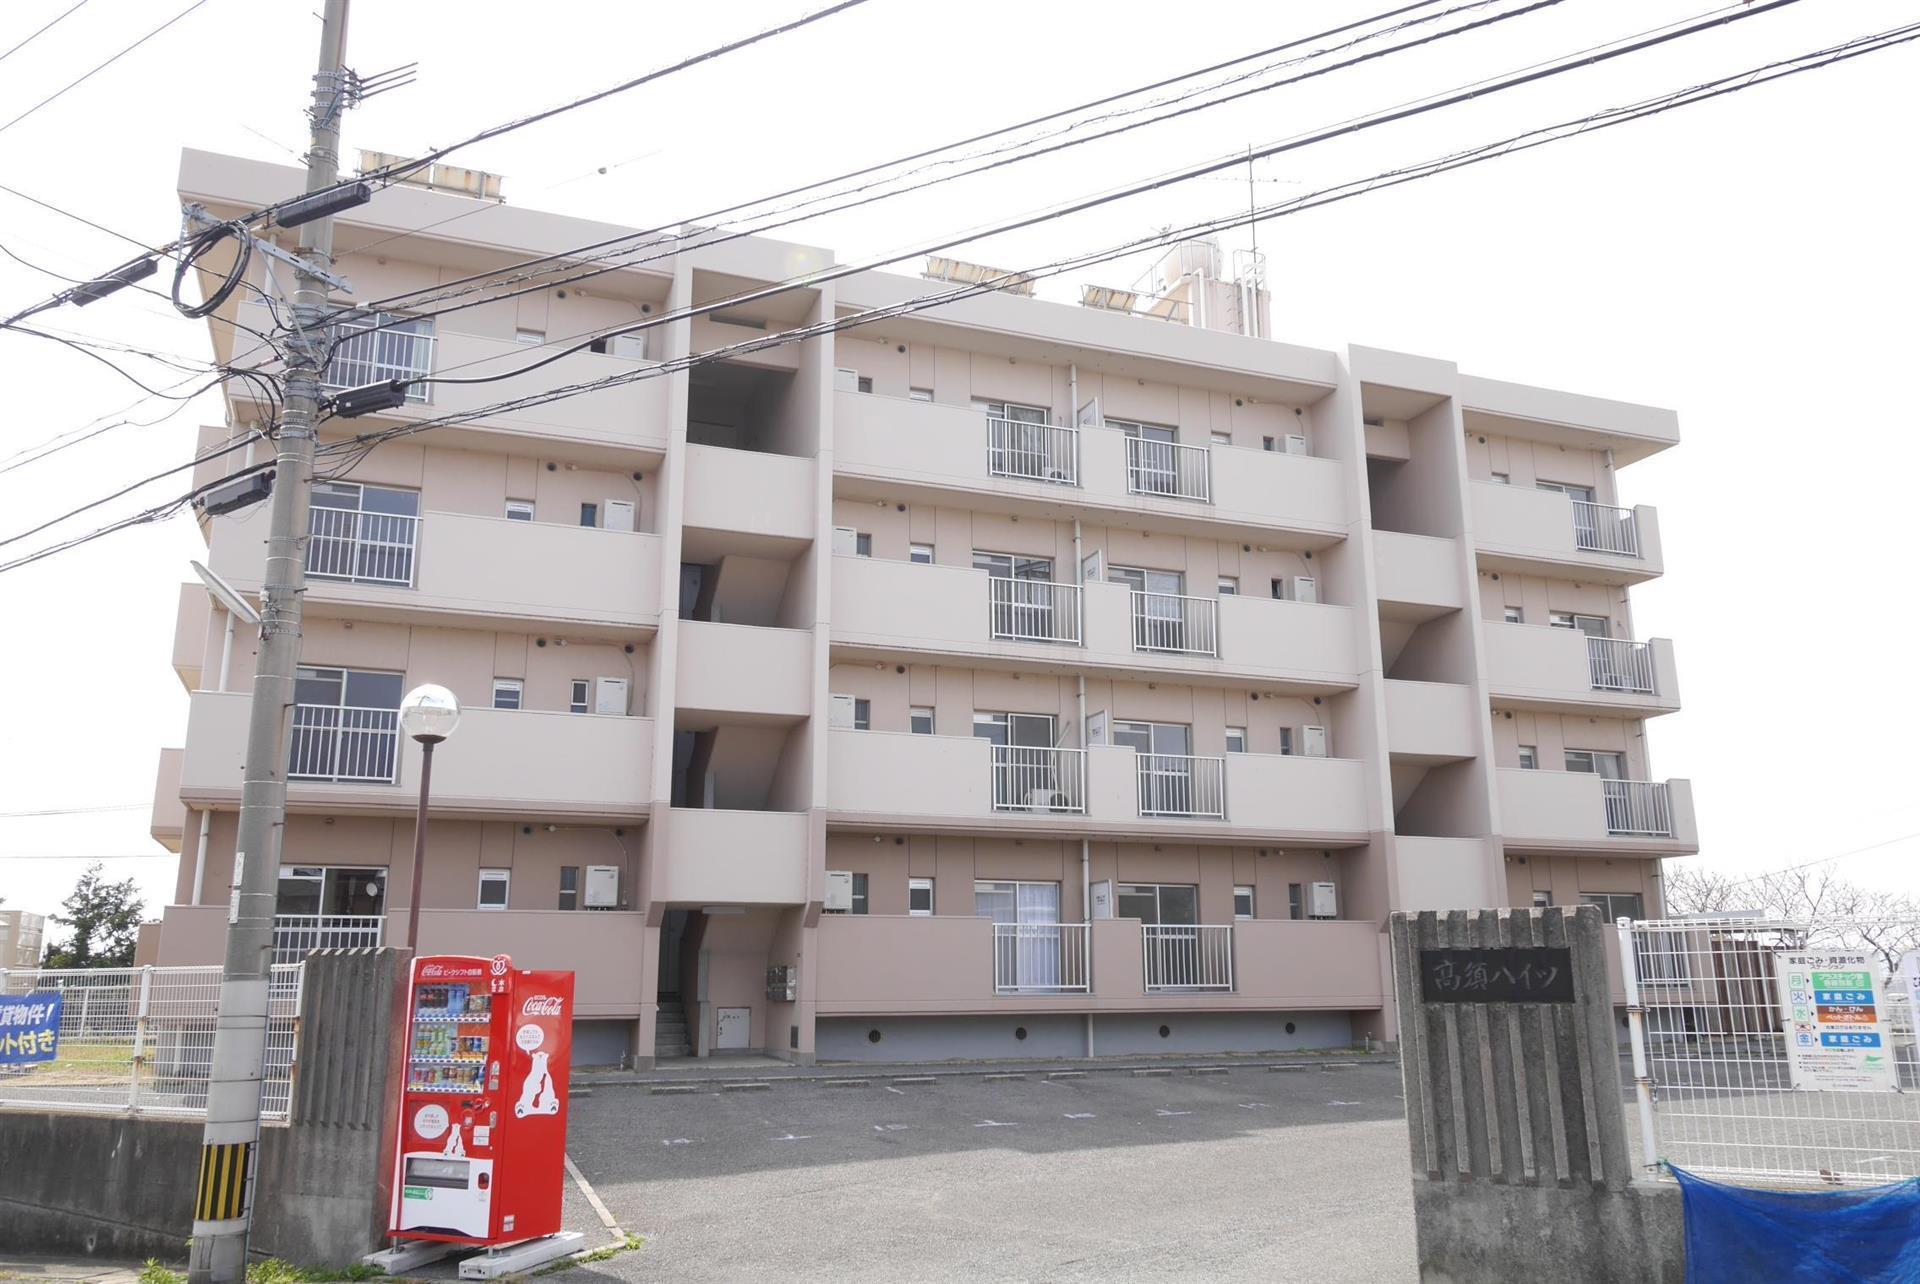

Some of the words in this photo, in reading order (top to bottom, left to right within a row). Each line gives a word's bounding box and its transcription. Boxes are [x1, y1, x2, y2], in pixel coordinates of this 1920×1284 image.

[1433, 960, 1558, 991] 高須ハイツ
[1794, 991, 1804, 1001] 火
[0, 1003, 55, 1026] 貸物件!
